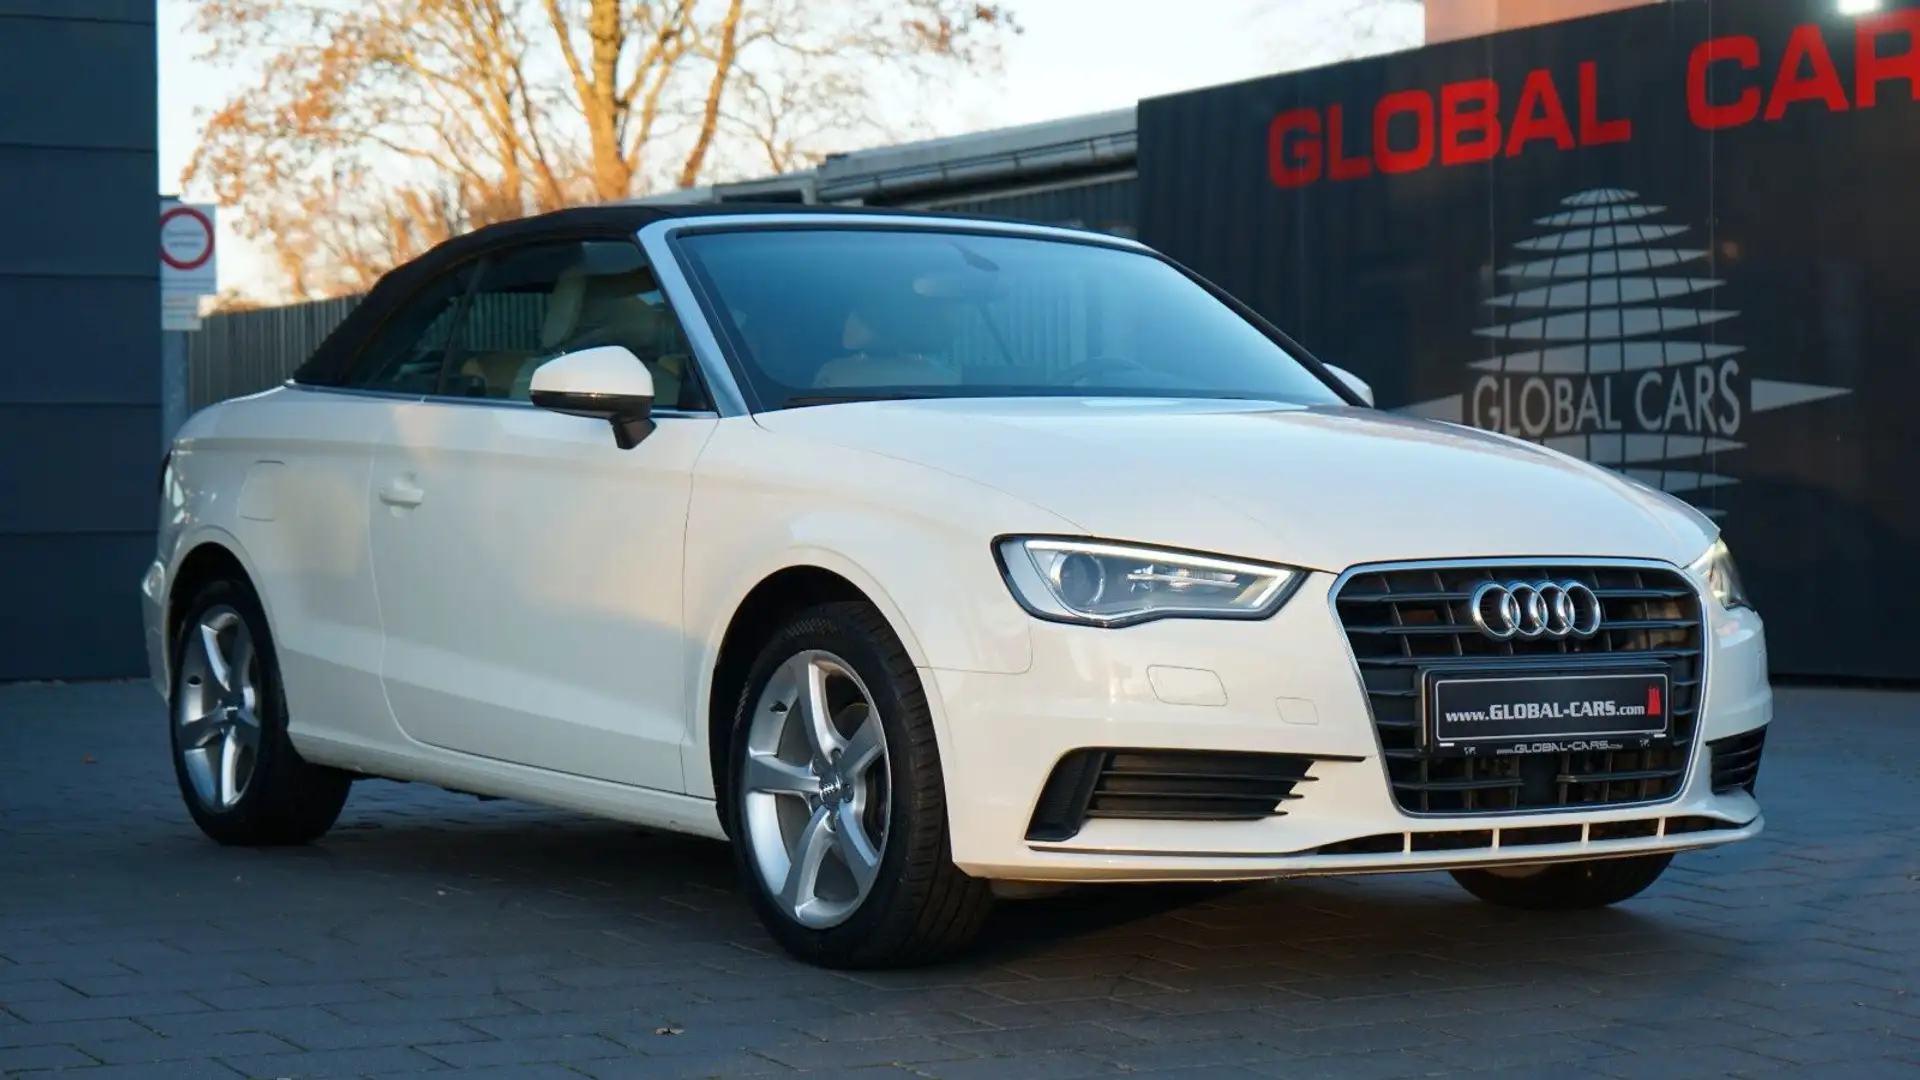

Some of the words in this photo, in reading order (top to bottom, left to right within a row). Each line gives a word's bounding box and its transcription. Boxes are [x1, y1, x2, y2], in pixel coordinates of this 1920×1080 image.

[1268, 61, 1632, 188] GLOBAL
[1472, 375, 1622, 436] GLOBAL
[1635, 359, 1741, 436] CARS
[1446, 701, 1645, 722] www.GLOBAL-CARS.com
[1496, 740, 1622, 754] .GLOBAL-CARS.
